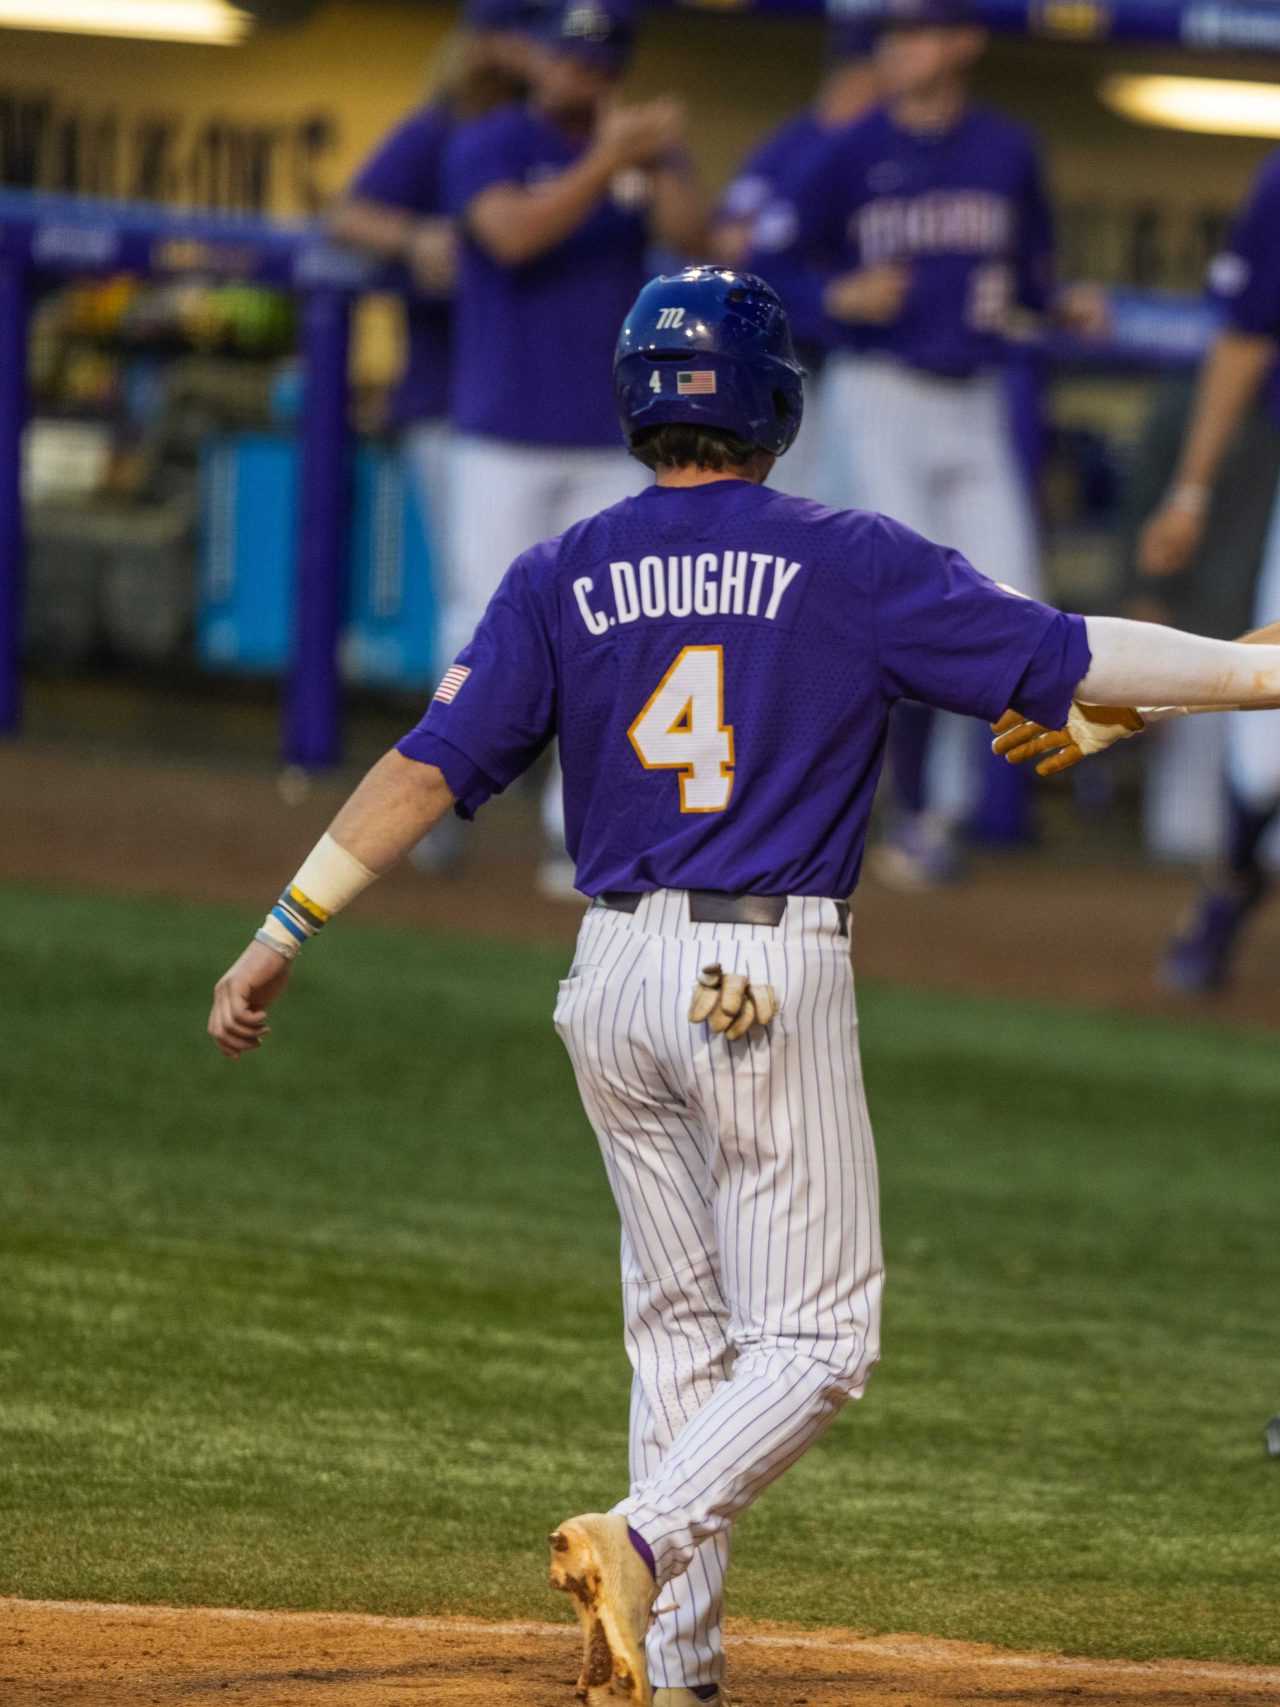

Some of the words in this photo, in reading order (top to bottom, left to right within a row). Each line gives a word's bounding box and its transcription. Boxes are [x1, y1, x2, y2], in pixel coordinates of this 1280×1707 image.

[649, 370, 662, 394] 4
[572, 550, 802, 636] C.DOUGHTY
[626, 643, 736, 814] 4
